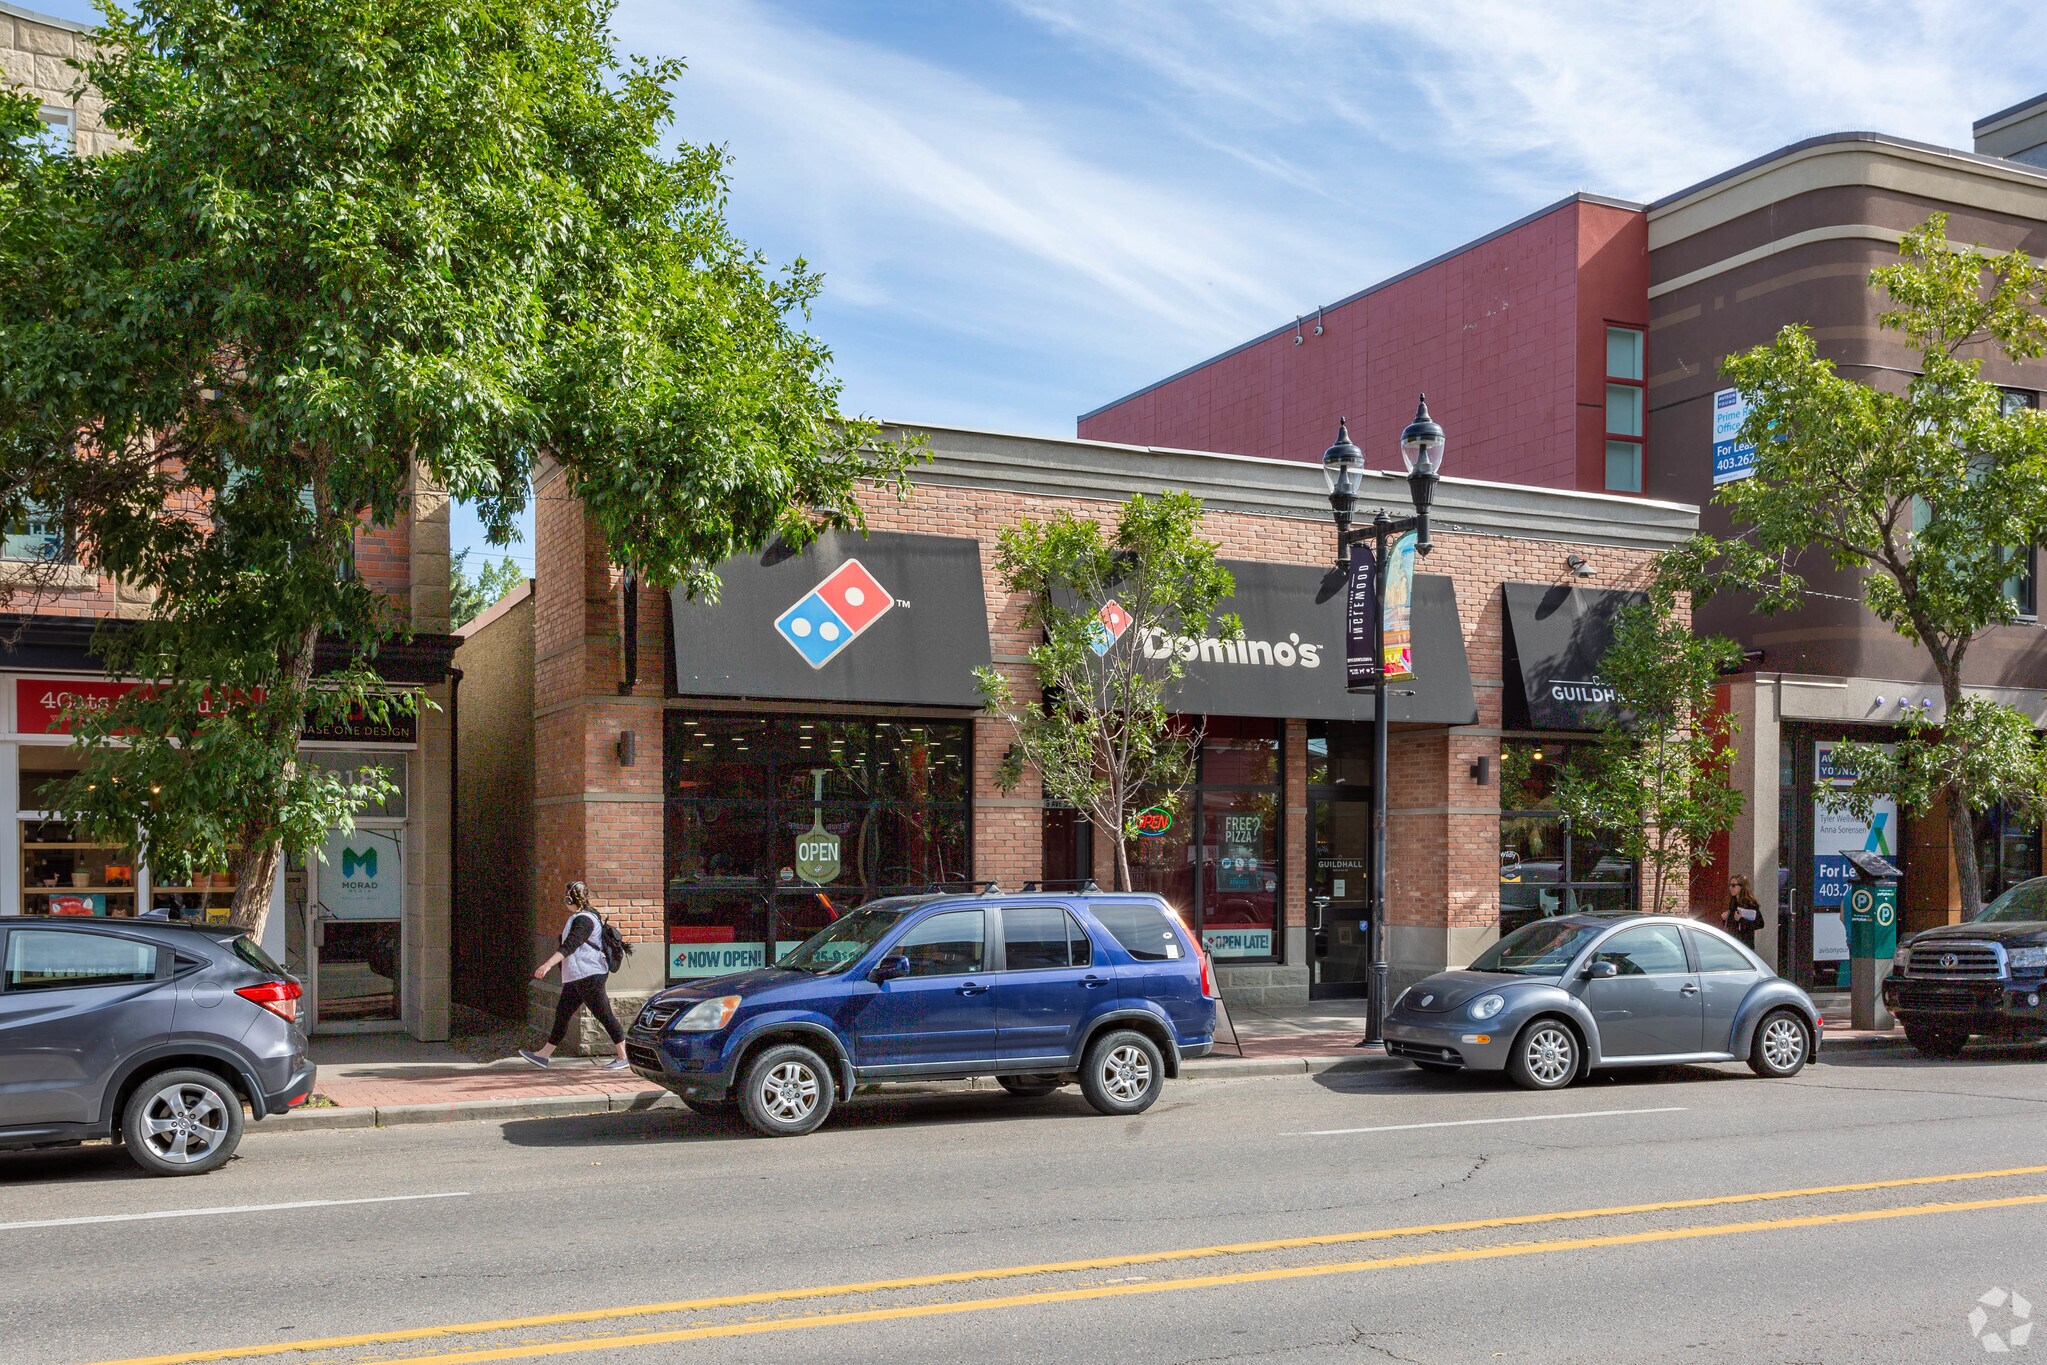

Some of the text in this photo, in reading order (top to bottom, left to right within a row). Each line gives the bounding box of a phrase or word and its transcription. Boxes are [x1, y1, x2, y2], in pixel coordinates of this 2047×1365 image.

[1717, 410, 1740, 423] Prime
[1717, 422, 1741, 434] Office
[1717, 446, 1731, 457] For
[334, 725, 360, 736] ONE
[364, 726, 410, 737] DESIGN
[1135, 814, 1169, 829] OPEN
[1225, 816, 1252, 831] FREE
[1820, 814, 1835, 824] Tyler
[1820, 825, 1867, 834] Anna Sorensen
[1225, 830, 1252, 843] PIZZA
[798, 842, 839, 861] OPEN
[1318, 860, 1363, 868] GUILDHALL
[1820, 864, 1839, 878] For
[342, 881, 378, 889] MORAD
[1215, 934, 1269, 949] OPEN LATE!
[687, 951, 720, 968] NOW
[723, 950, 762, 967] OPEN!
